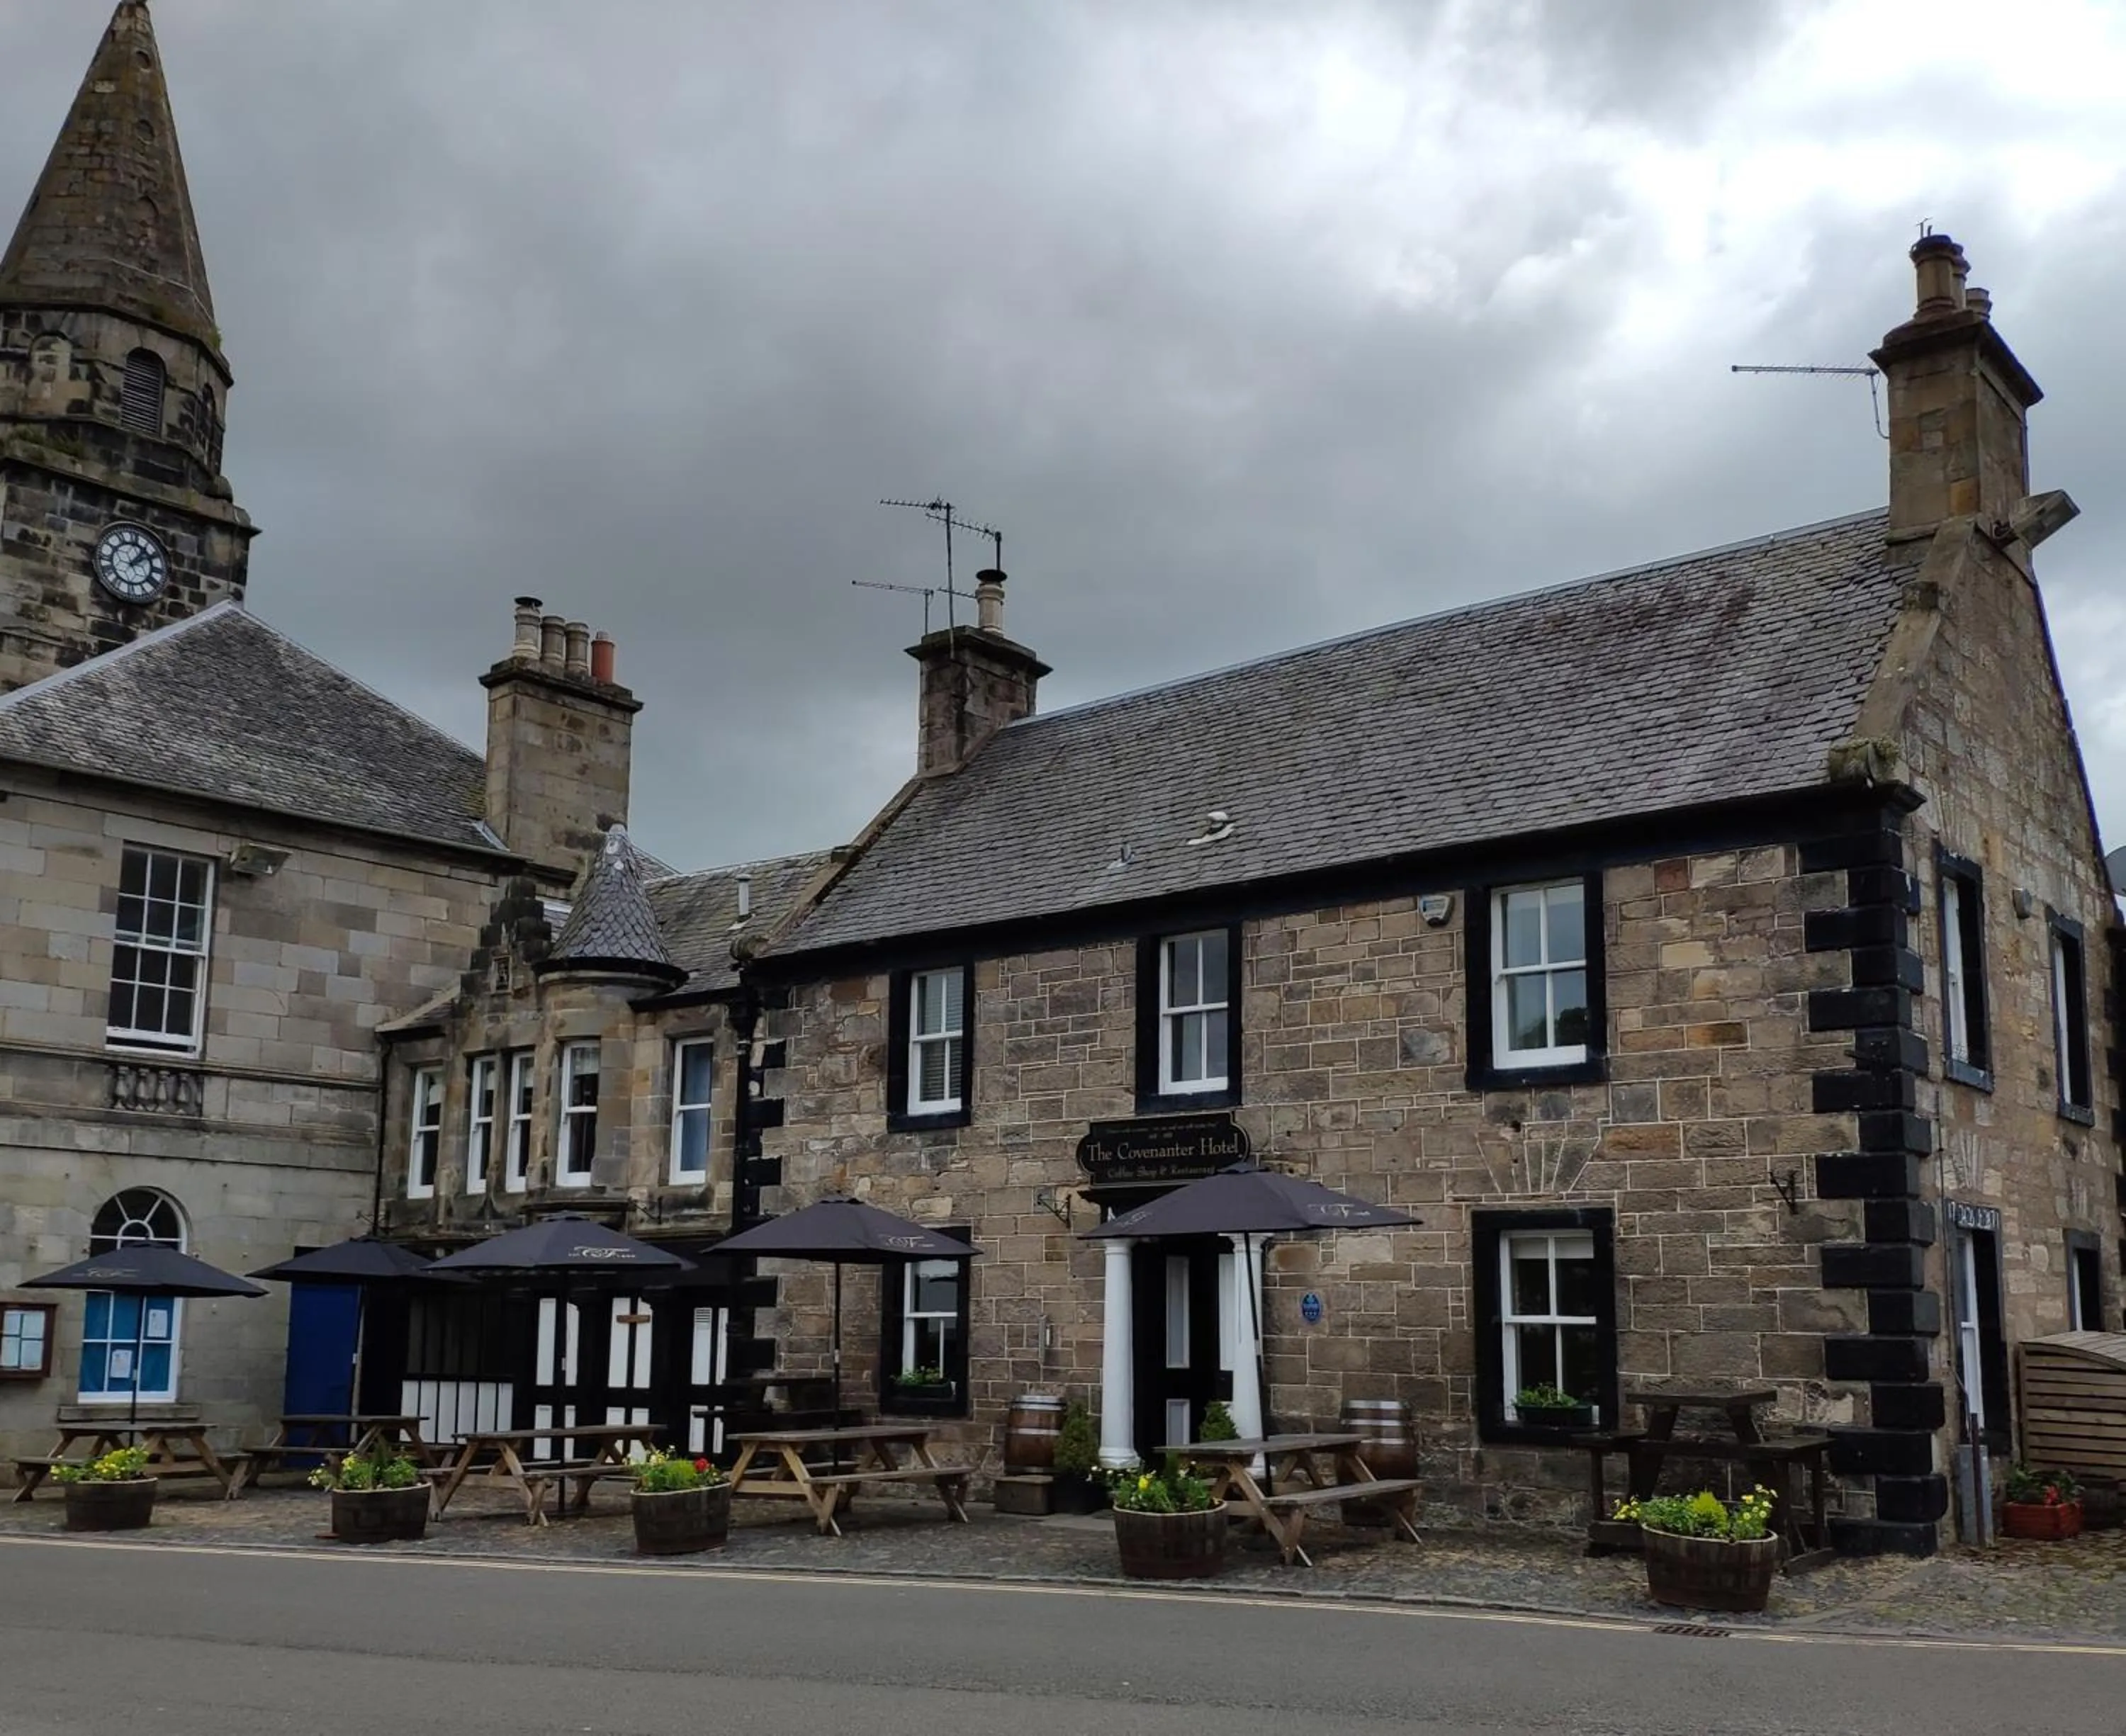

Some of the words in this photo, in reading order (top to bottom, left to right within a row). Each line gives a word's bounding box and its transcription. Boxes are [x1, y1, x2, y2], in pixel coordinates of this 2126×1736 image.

[1086, 1141, 1113, 1162] The
[1117, 1142, 1196, 1161] Covenanter
[1200, 1133, 1239, 1156] Hotel
